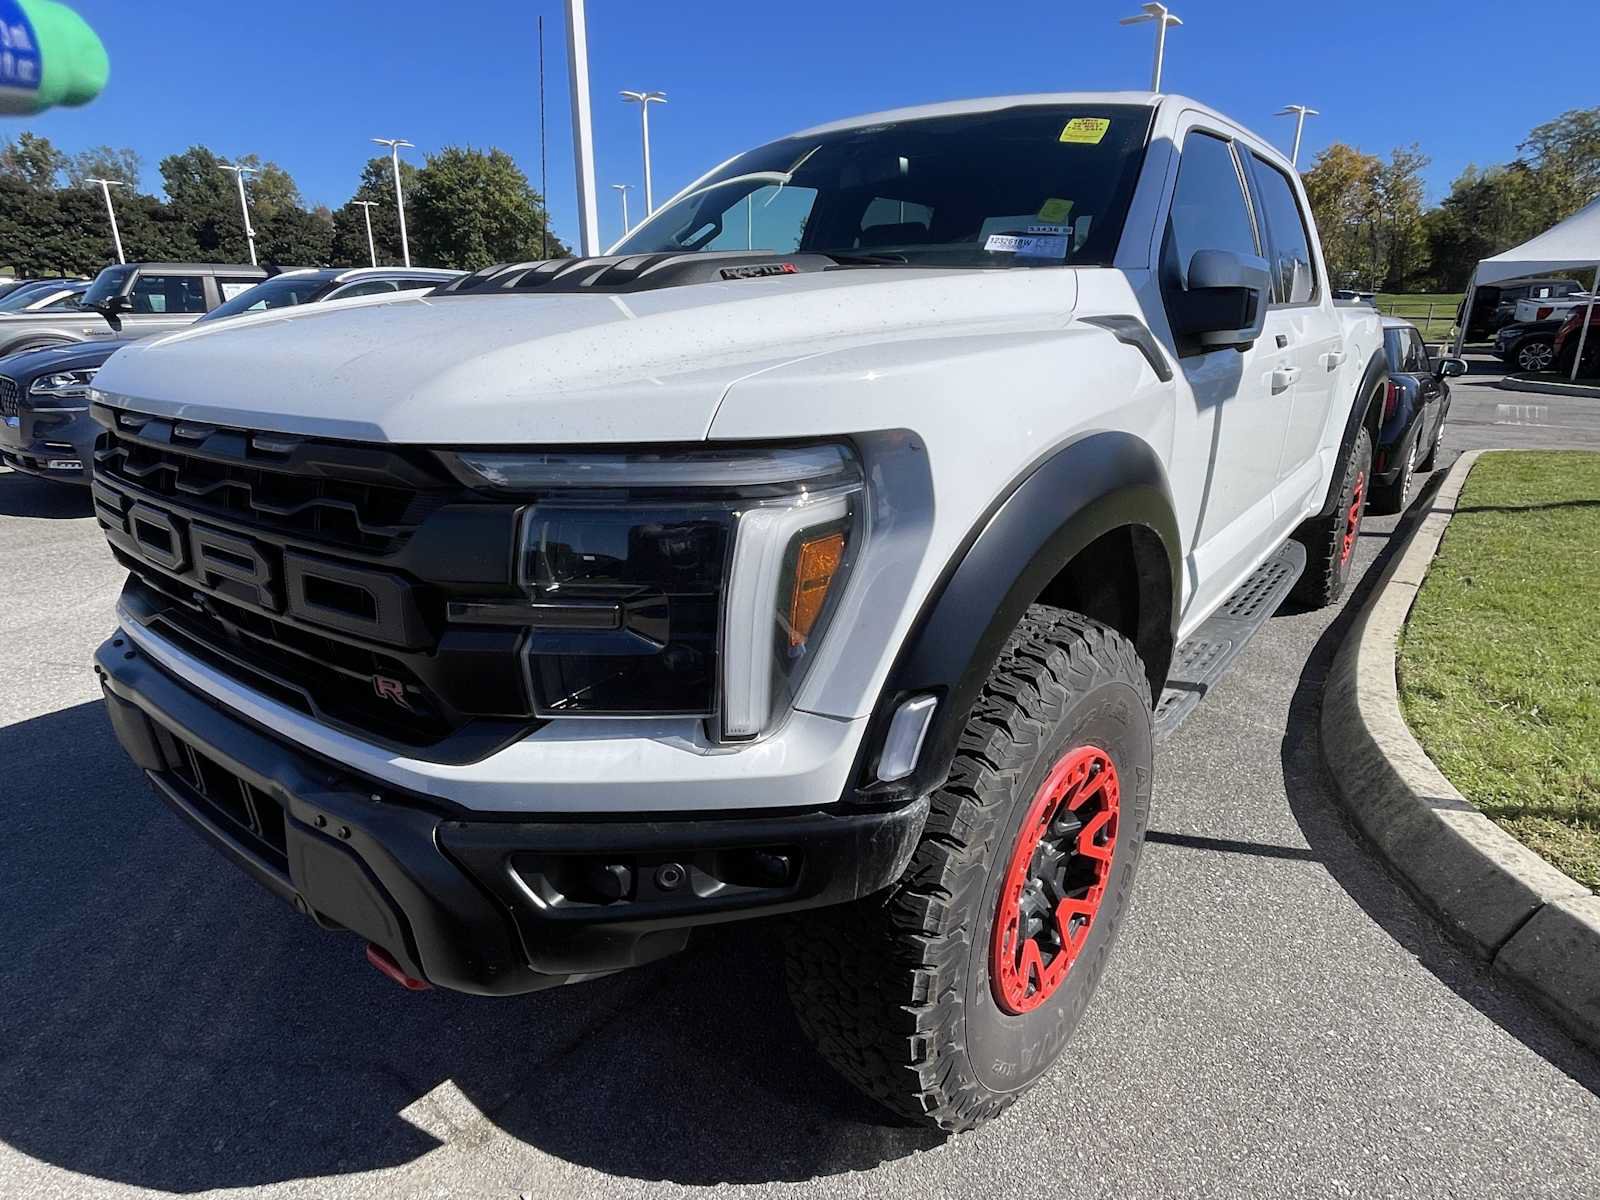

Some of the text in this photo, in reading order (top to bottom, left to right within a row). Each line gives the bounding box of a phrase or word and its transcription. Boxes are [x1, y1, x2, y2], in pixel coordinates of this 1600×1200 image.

[720, 262, 798, 281] RAPTOR
[91, 479, 415, 650] FORD
[371, 674, 416, 714] R
